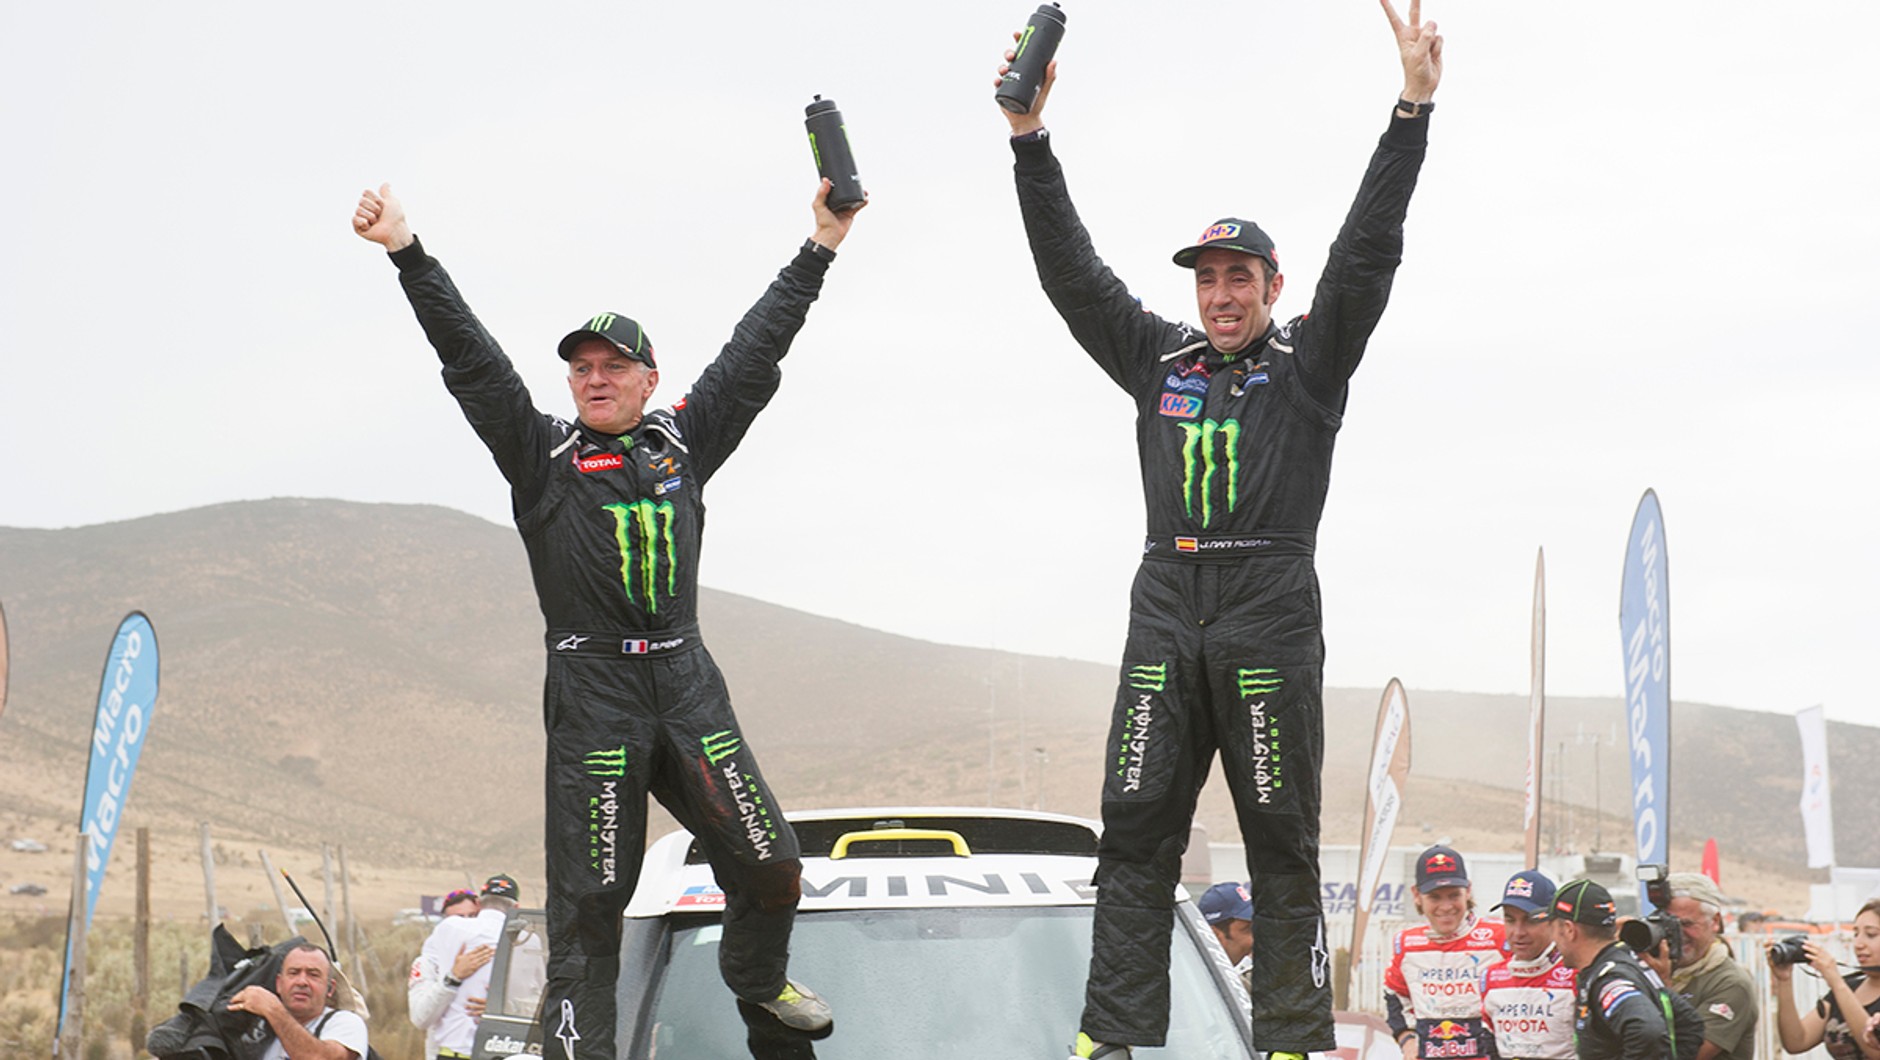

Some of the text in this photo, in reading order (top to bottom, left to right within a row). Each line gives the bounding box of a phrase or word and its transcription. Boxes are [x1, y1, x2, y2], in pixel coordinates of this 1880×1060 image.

[1163, 396, 1199, 414] KH-7
[581, 457, 621, 470] TOTAL
[1641, 519, 1664, 683] Macro
[93, 630, 142, 758] Macro
[1116, 708, 1135, 777] ENERGY
[1123, 694, 1153, 793] MONSTER
[1250, 700, 1273, 804] MONSTER
[1269, 716, 1282, 788] ENERGY
[1628, 617, 1657, 862] Macro
[589, 796, 599, 870] ENERGY
[600, 781, 619, 886] MONSTER
[723, 761, 772, 861] MONSTER
[743, 773, 777, 840] ENERGY
[799, 872, 1051, 899] MINI
[1422, 982, 1476, 996] TOYOTA
[1425, 1038, 1478, 1058] Red Bull
[1496, 1019, 1550, 1033] TOYOTA
